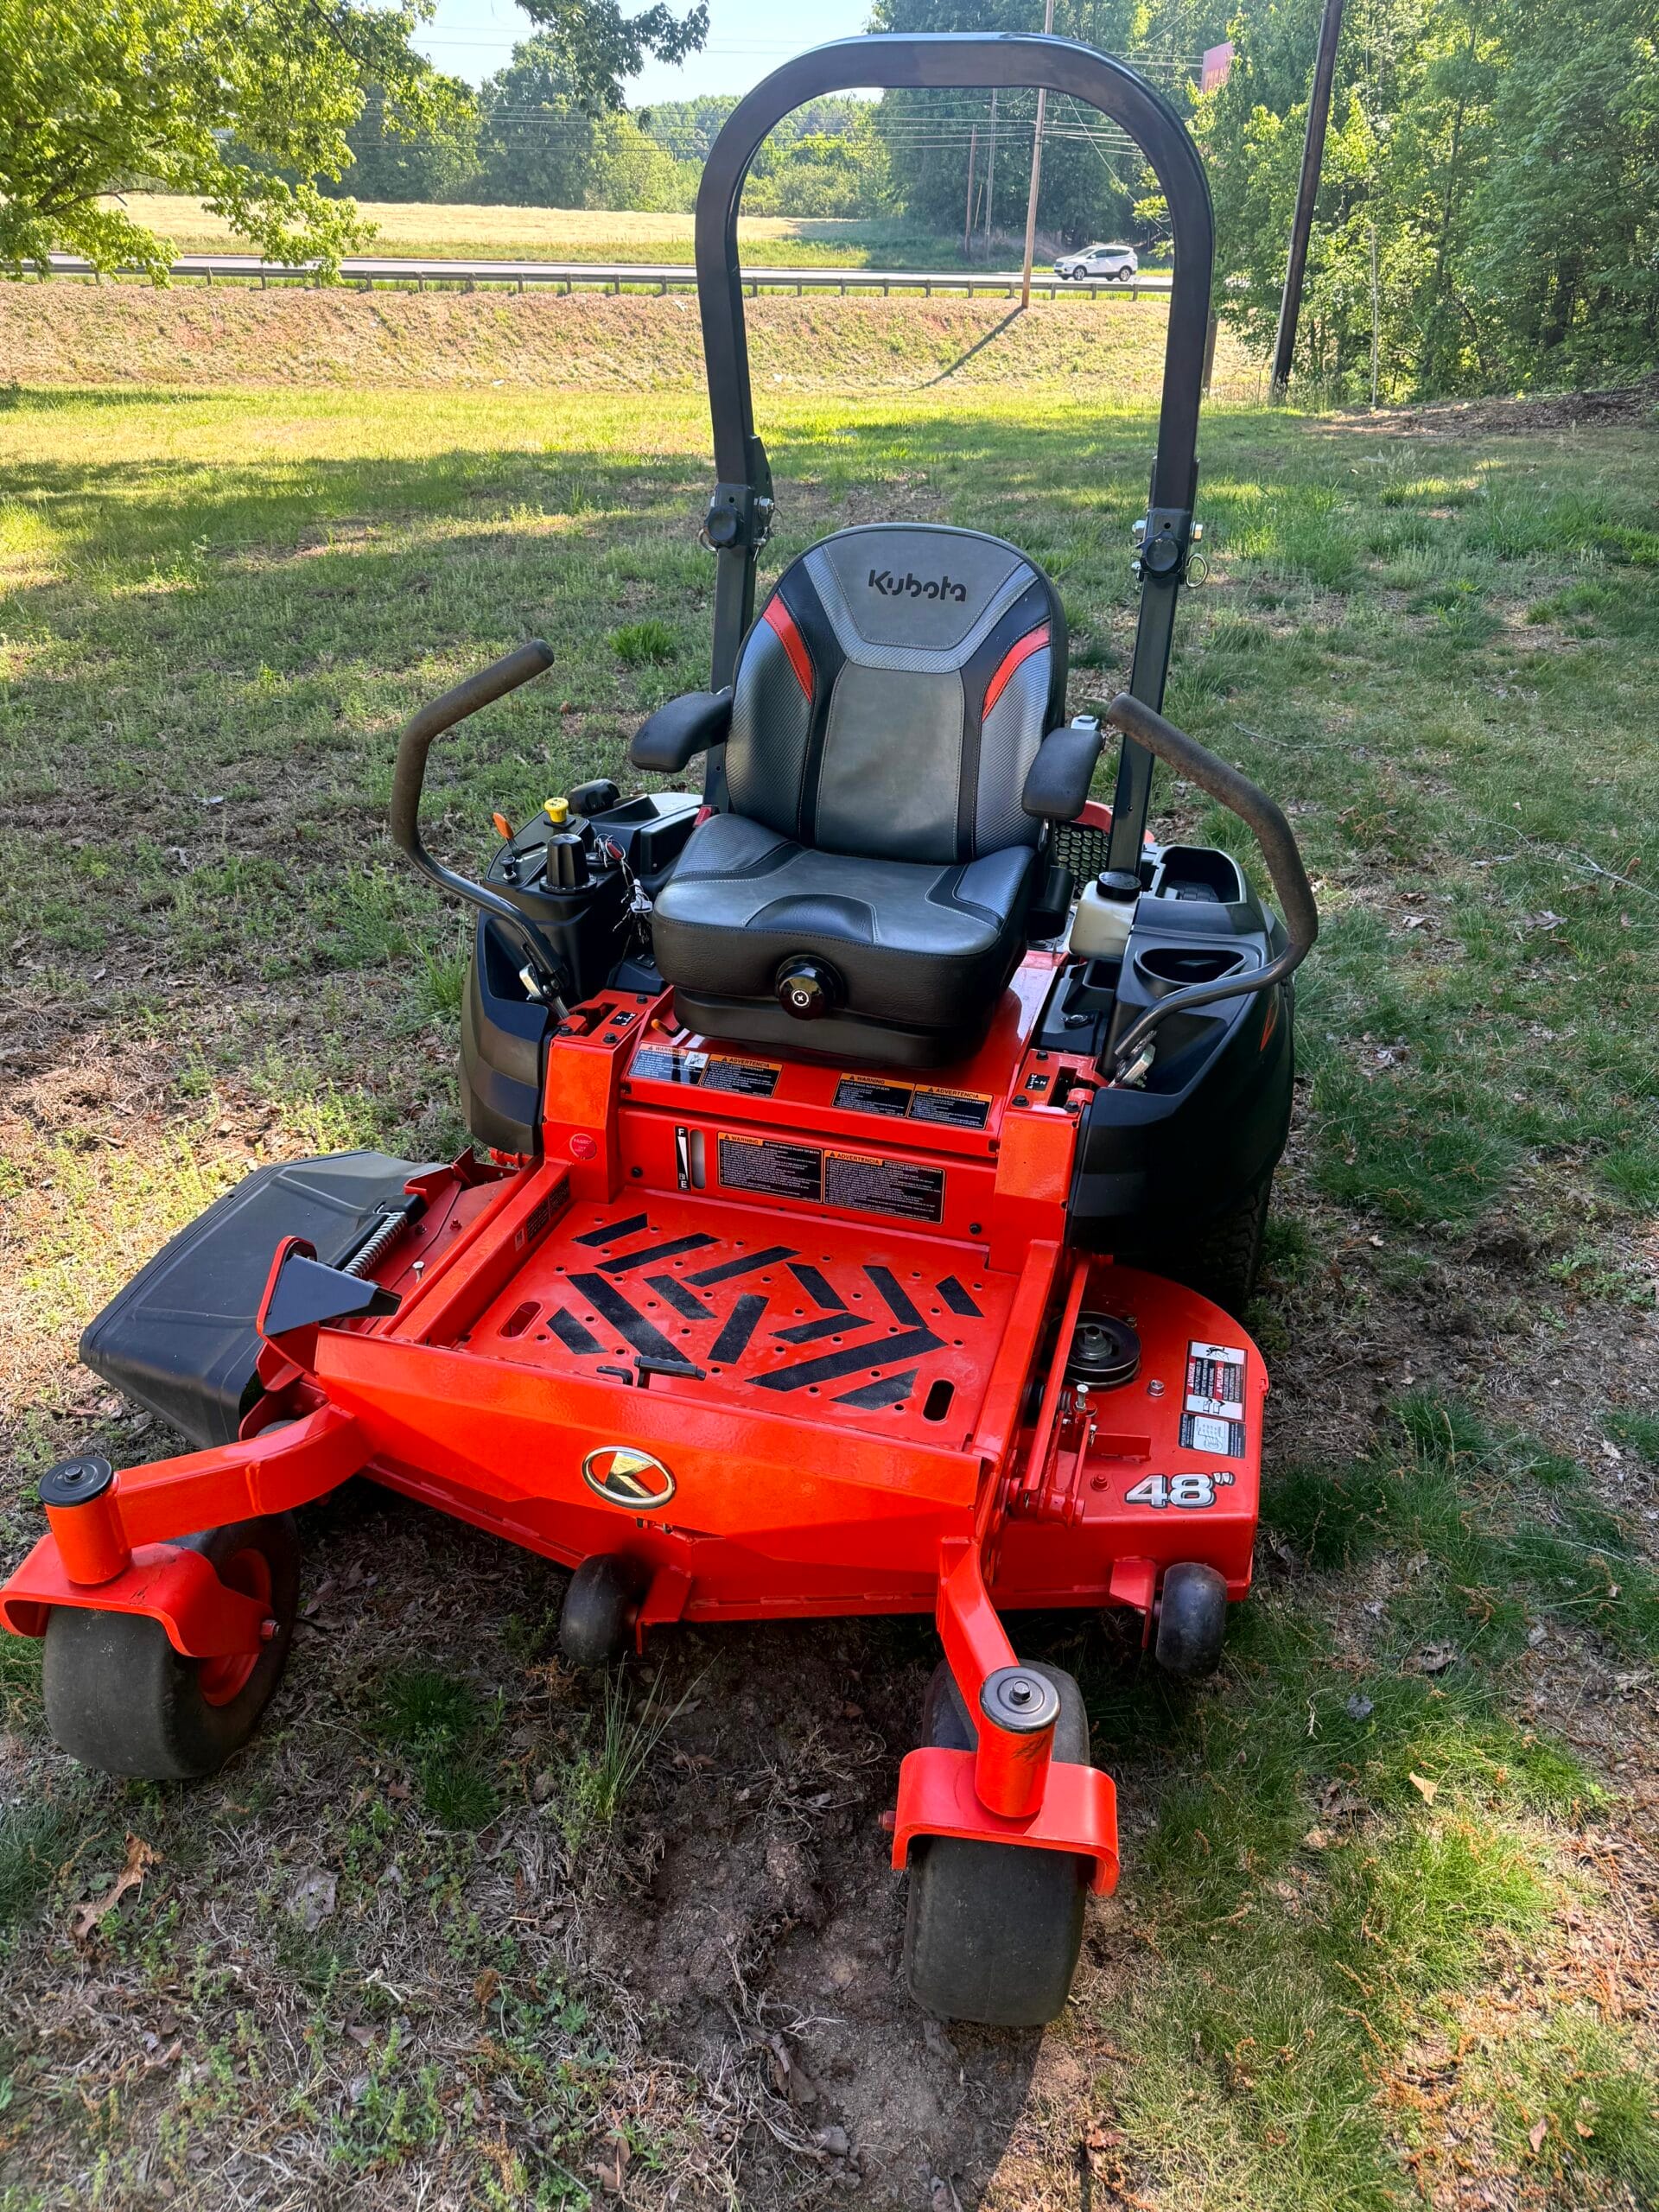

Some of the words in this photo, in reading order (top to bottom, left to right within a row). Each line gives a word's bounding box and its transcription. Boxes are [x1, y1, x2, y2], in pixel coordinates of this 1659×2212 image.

[868, 569, 967, 601] Kubota
[728, 1057, 770, 1068] ADVERTENCIA
[857, 1076, 885, 1084] WARNING
[936, 1088, 979, 1099] ADVERTENCIA
[731, 1135, 759, 1145] WARNING
[836, 1153, 880, 1164] ADVERTENCIA
[1126, 1472, 1234, 1508] 48"
